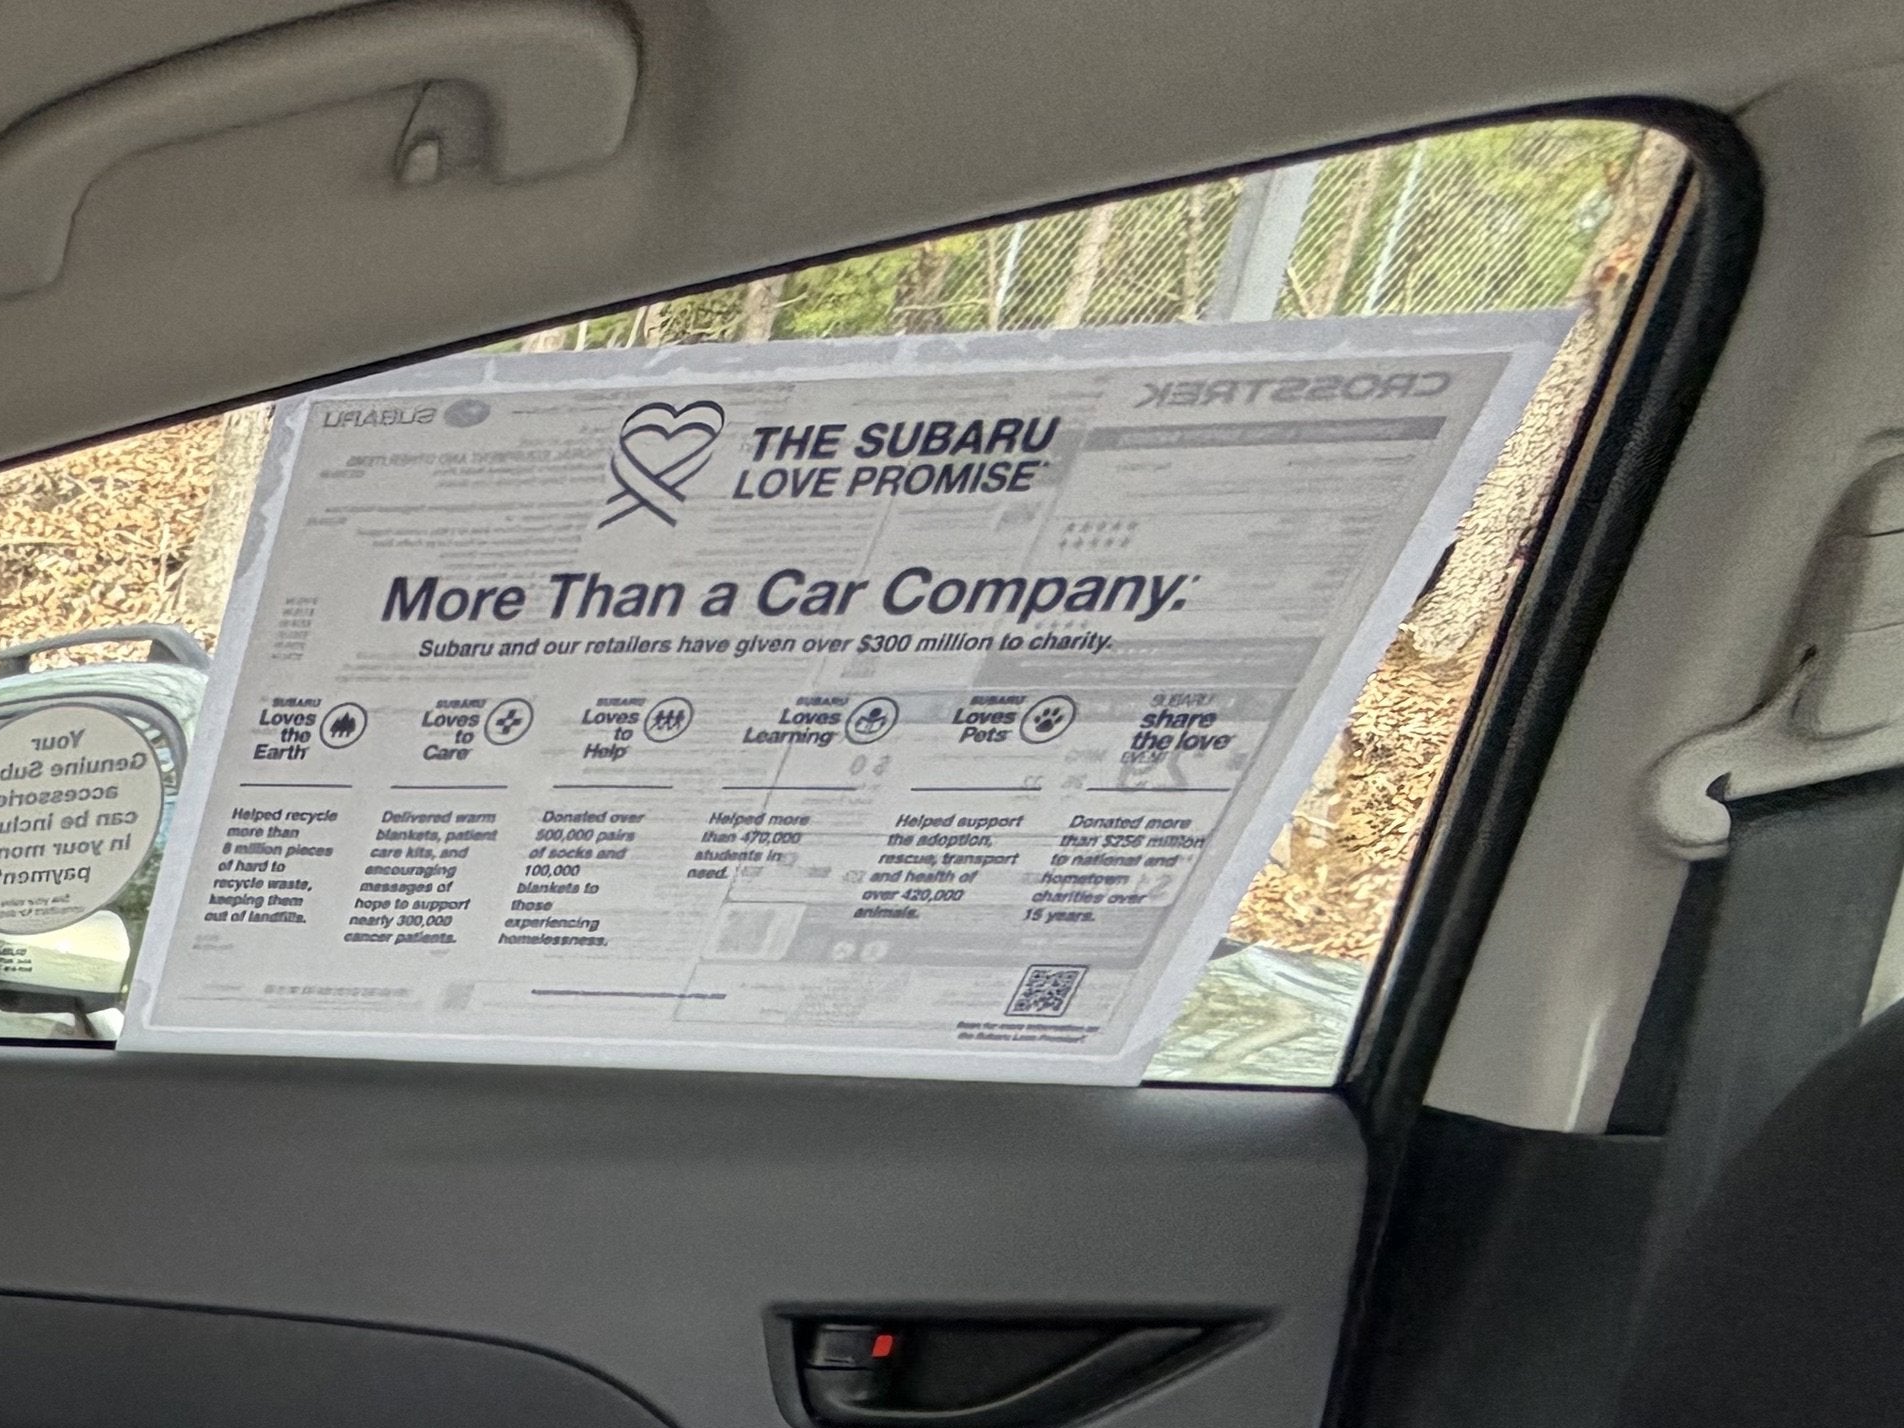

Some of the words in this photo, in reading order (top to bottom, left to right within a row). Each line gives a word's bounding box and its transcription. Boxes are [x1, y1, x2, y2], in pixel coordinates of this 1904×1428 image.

[751, 424, 846, 460] THE
[853, 415, 1060, 458] SUBARU
[732, 468, 840, 499] LOVE
[380, 576, 526, 622] More
[548, 572, 686, 620] Than
[700, 580, 738, 618] a
[757, 568, 868, 617] Car
[418, 638, 494, 658] Subaru
[498, 637, 539, 656] and
[543, 641, 581, 655] our
[585, 636, 672, 655] retailers
[676, 635, 730, 654] have
[735, 635, 796, 658] given
[803, 638, 853, 653] over
[858, 633, 912, 654] $300
[916, 633, 993, 652] million
[998, 634, 1024, 651] to
[1027, 632, 1114, 656] charity.
[259, 709, 317, 726] Loves
[421, 711, 480, 728] Loves
[582, 709, 640, 725] Loves
[779, 708, 843, 725] Loves
[952, 708, 1016, 725] Loves
[1140, 710, 1217, 728] share
[281, 728, 311, 743] the
[455, 730, 474, 744] to
[614, 727, 633, 741] to
[1130, 731, 1174, 750] the
[232, 808, 282, 823] Helped
[285, 810, 338, 825] recycle
[382, 811, 453, 824] Delivered
[456, 813, 496, 824] warm
[542, 811, 607, 823] Donated
[609, 813, 644, 822] over
[709, 812, 766, 828] Helped
[769, 815, 810, 825] more
[896, 814, 956, 830] Helped
[957, 816, 1024, 830] support
[1069, 815, 1144, 829] Donated
[1145, 818, 1191, 829] more
[227, 827, 263, 838] more
[267, 827, 299, 838] than
[376, 829, 441, 843] blankets,
[445, 830, 498, 843] patient
[596, 830, 636, 844] pairs
[701, 832, 735, 843] than
[888, 834, 913, 846] the
[1059, 835, 1098, 847] than
[1146, 835, 1205, 848] million
[234, 843, 282, 855] million
[285, 844, 334, 857] pieces
[370, 849, 402, 858] care
[406, 847, 436, 860] kits,
[439, 847, 469, 858] and
[529, 847, 546, 859] of
[548, 847, 593, 859] socks
[596, 848, 628, 860] and
[694, 850, 762, 862] students
[766, 850, 782, 862] in
[218, 860, 232, 872] of
[235, 860, 268, 872] hard
[271, 861, 285, 872] to
[942, 854, 1019, 867] transport
[1050, 854, 1070, 865] to
[1071, 853, 1142, 866] national
[1143, 855, 1180, 867] and
[365, 865, 457, 877] encouraging
[525, 865, 581, 877] 100,000
[869, 871, 903, 882] and
[905, 871, 956, 883] health
[959, 871, 978, 882] of
[213, 878, 264, 892] recycle
[268, 879, 312, 892] waste,
[360, 883, 433, 895] messages
[437, 881, 453, 892] of
[517, 883, 579, 894] blankets
[584, 883, 599, 894] to
[863, 891, 899, 901] over
[1032, 891, 1105, 903] charities
[1107, 894, 1147, 904] over
[354, 898, 391, 911] hope
[395, 899, 408, 909] to
[412, 899, 471, 911] support
[511, 900, 553, 911] those
[204, 911, 227, 922] out
[231, 911, 245, 922] of
[349, 914, 393, 928] nearly
[505, 917, 599, 932] experiencing
[344, 933, 392, 942] cancer
